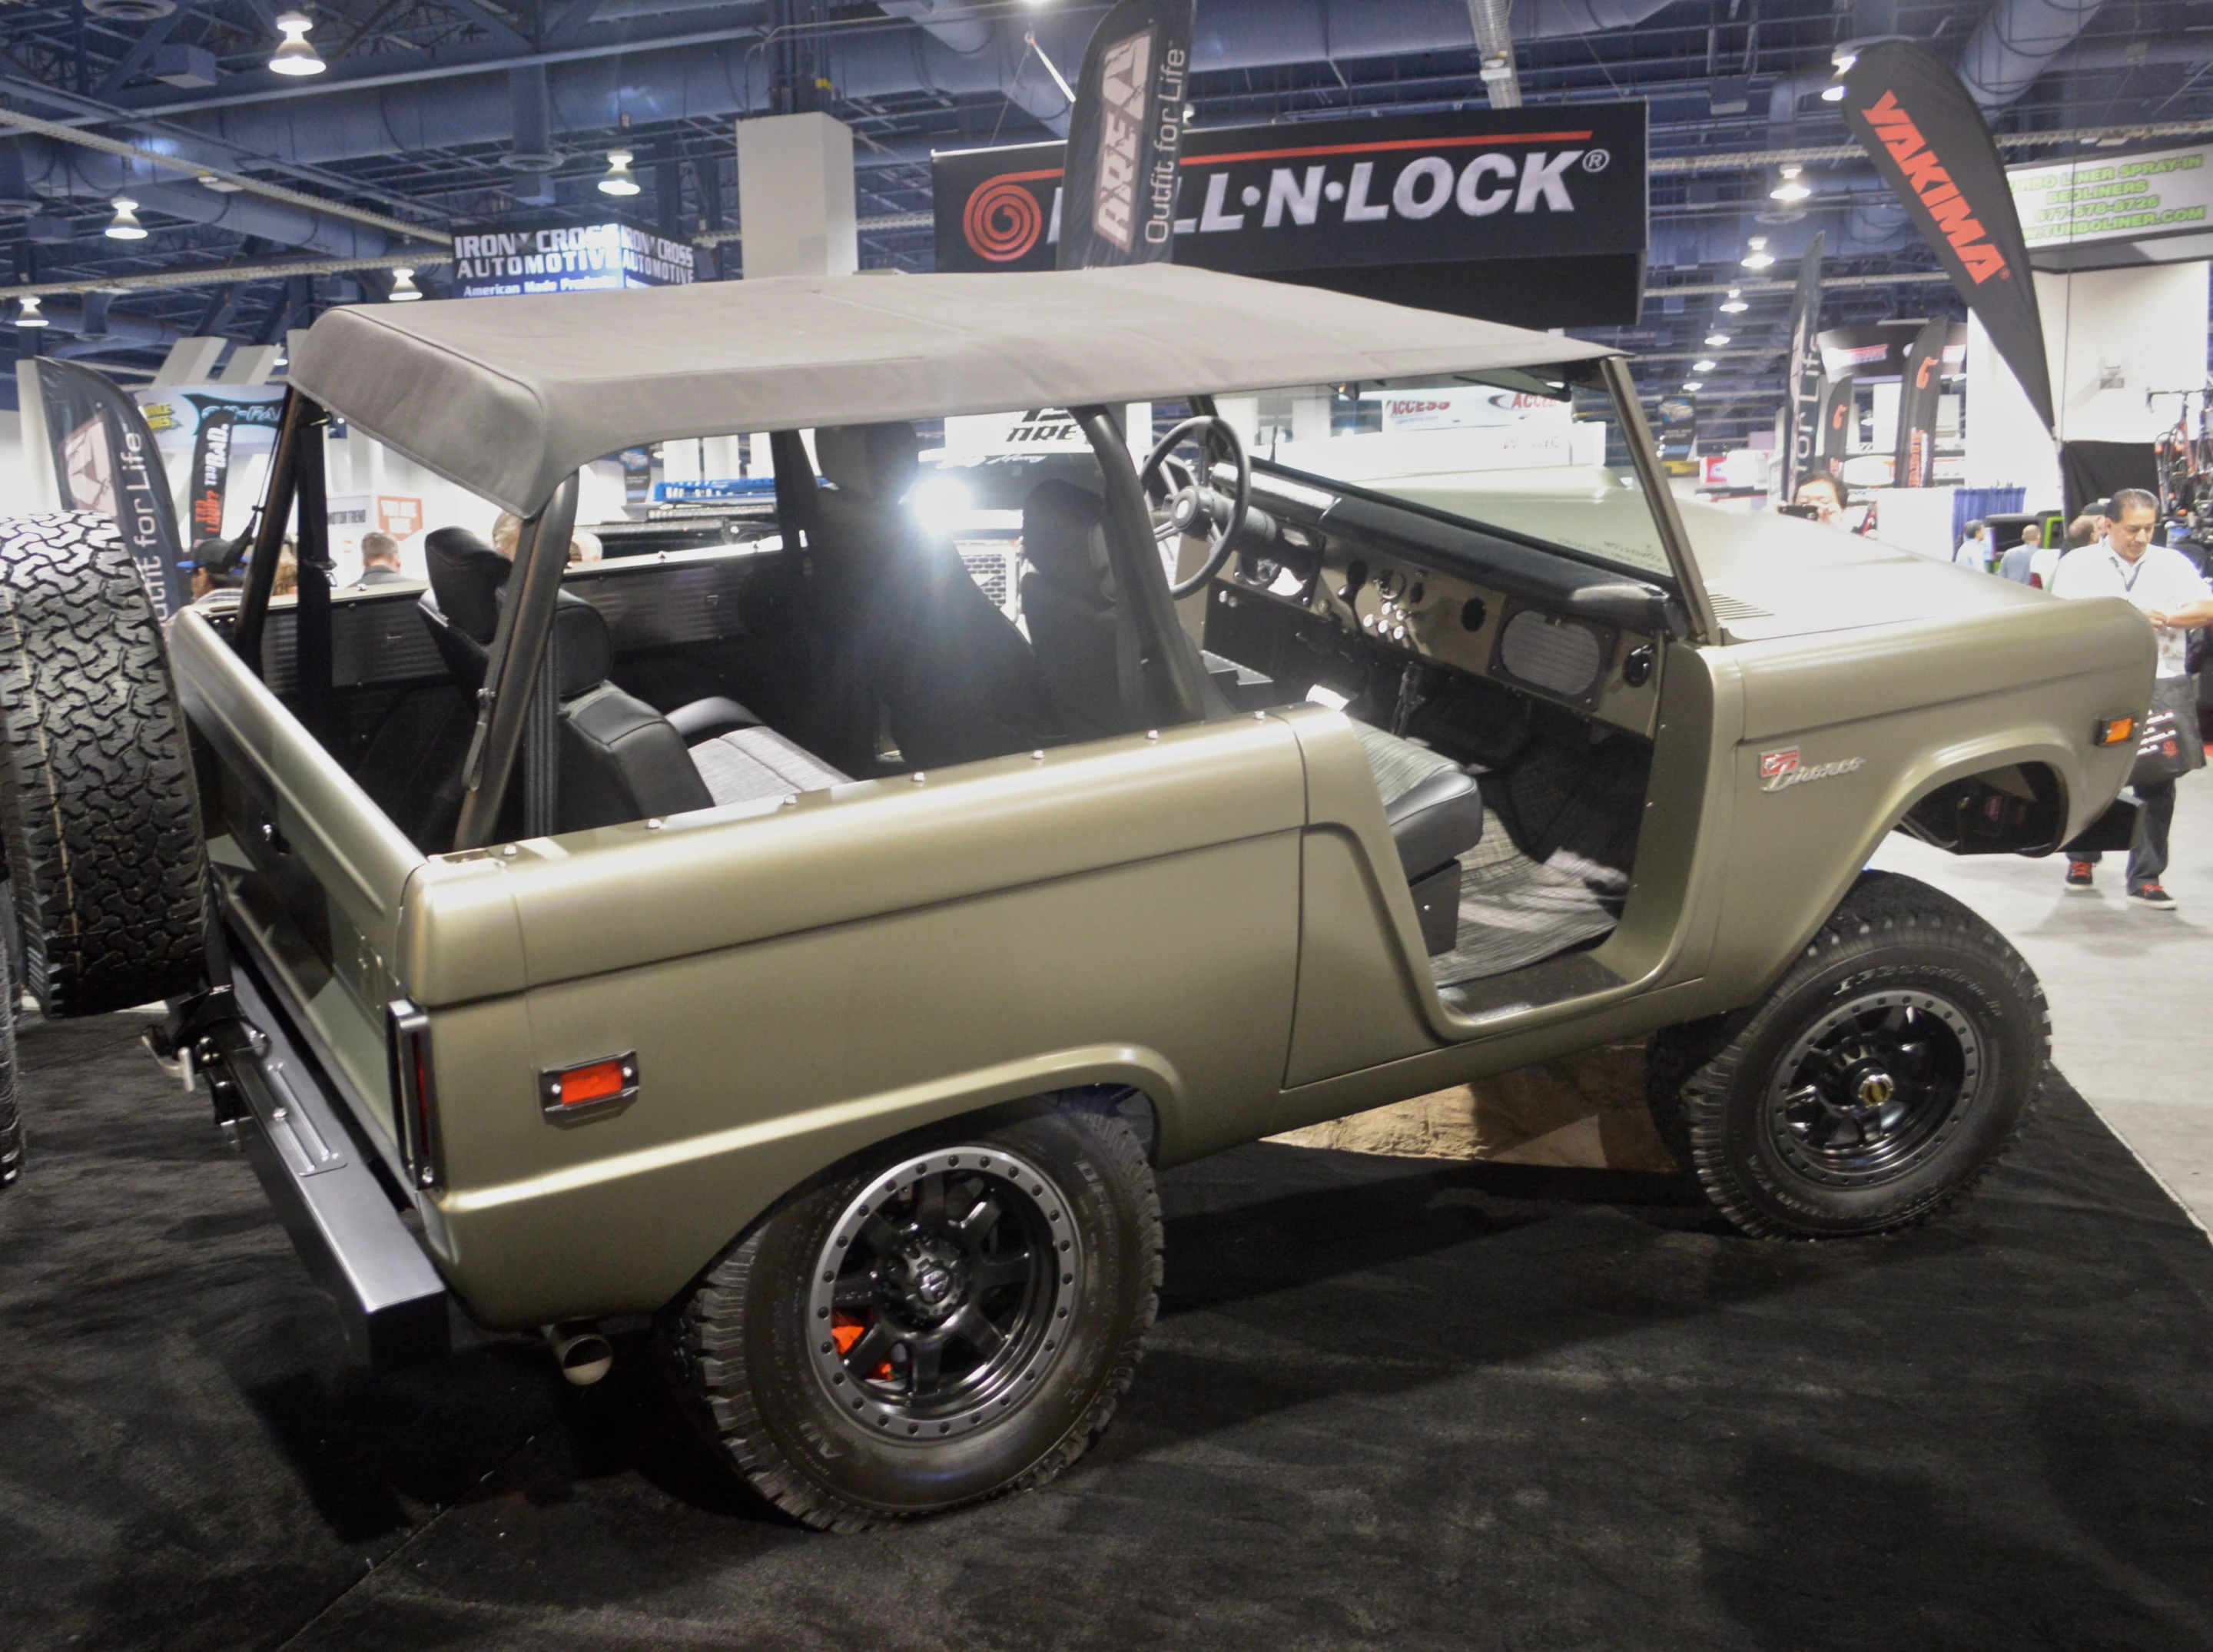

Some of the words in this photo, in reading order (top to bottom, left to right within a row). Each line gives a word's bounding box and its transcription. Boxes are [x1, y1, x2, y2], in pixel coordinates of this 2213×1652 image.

[1158, 48, 1185, 103] Life
[1154, 108, 1178, 153] for
[1861, 88, 2006, 285] YAKIMA
[2009, 174, 2058, 193] URBO
[2062, 167, 2115, 185] LINER
[2118, 154, 2204, 178] SPRAY-IN
[2047, 179, 2148, 205] BEDLINERS
[1145, 161, 1175, 244] Outfit
[454, 233, 517, 259] IRON
[536, 223, 620, 254] CROSS
[456, 247, 622, 279] AUTOMOTIVE
[620, 224, 650, 256] IRON
[657, 237, 694, 268] CROSS
[463, 284, 521, 297] American
[524, 280, 558, 294] Made
[622, 248, 695, 285] AUTOMOTIVE
[120, 432, 151, 491] Life
[133, 498, 157, 548] for
[141, 556, 169, 627] utfit
